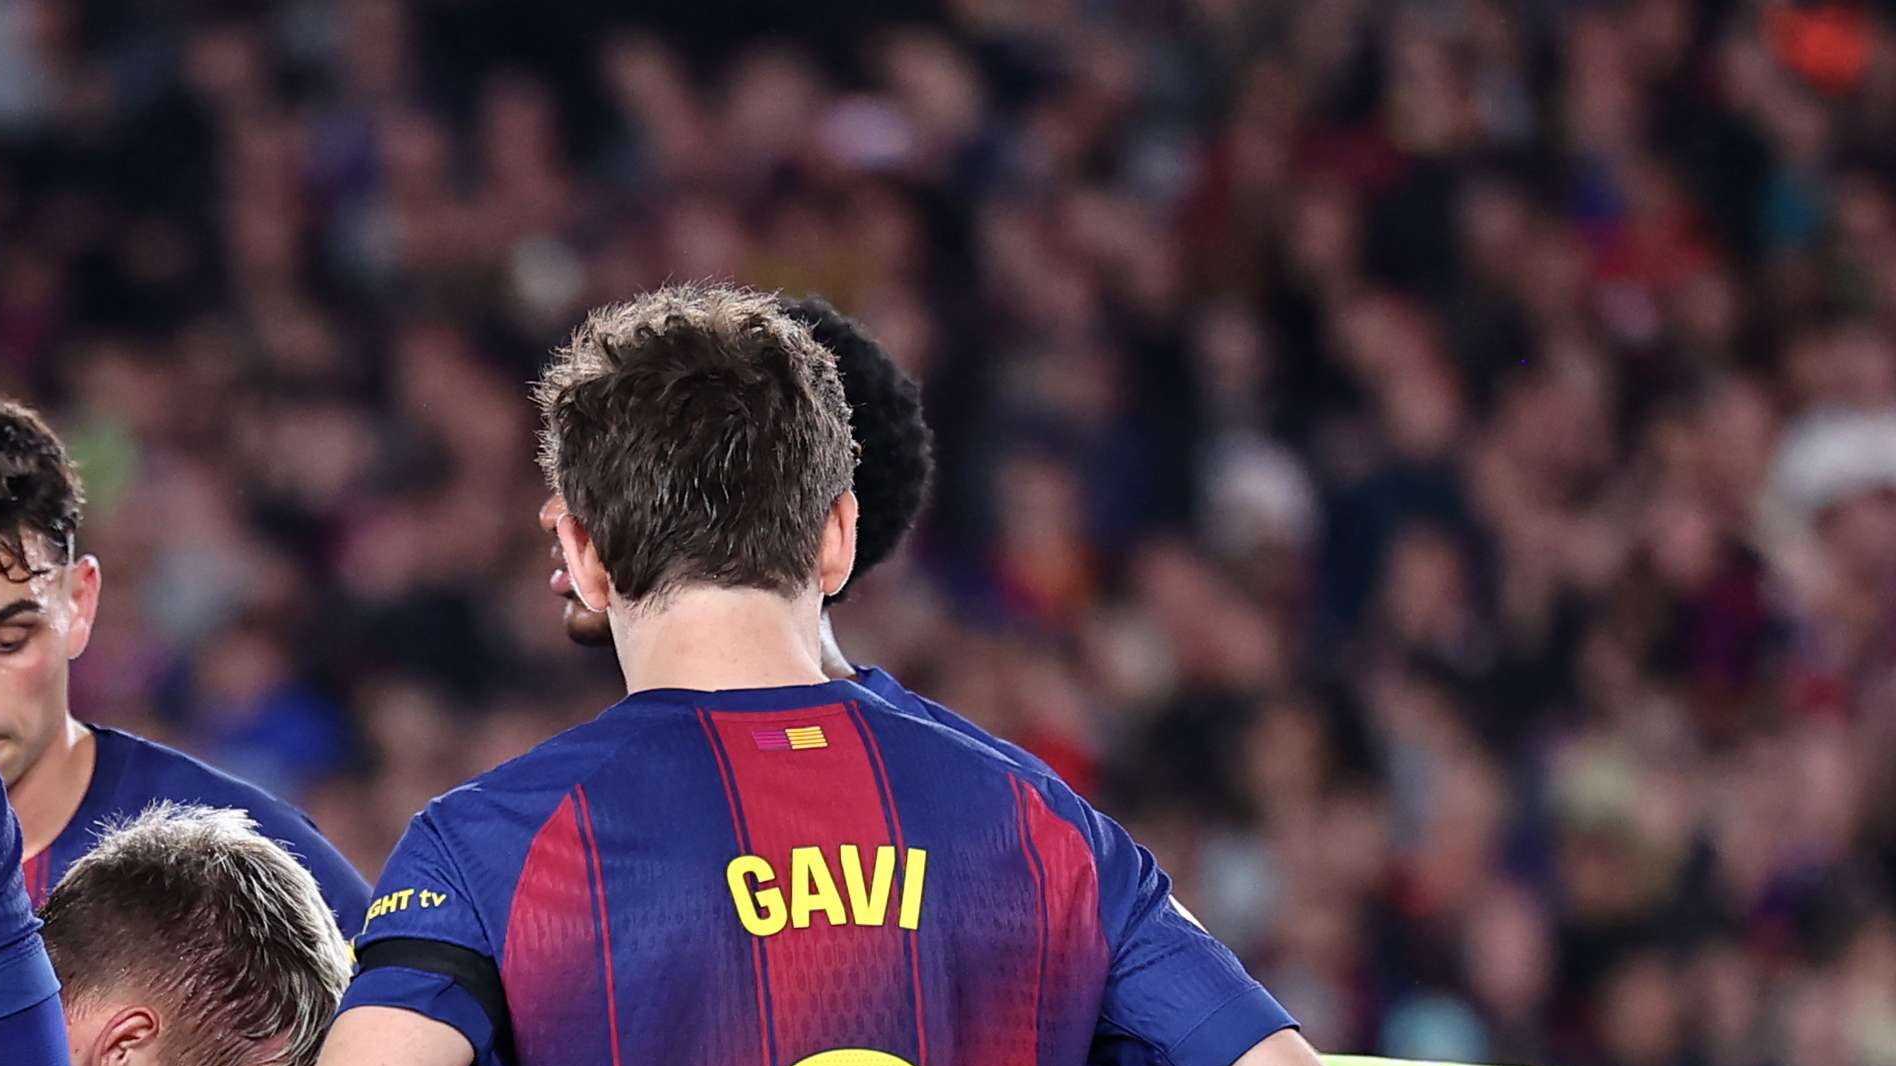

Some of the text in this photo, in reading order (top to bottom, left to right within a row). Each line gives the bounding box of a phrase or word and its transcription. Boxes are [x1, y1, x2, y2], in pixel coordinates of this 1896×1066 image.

[364, 888, 447, 927] GHT tv
[726, 844, 927, 937] GAVI
